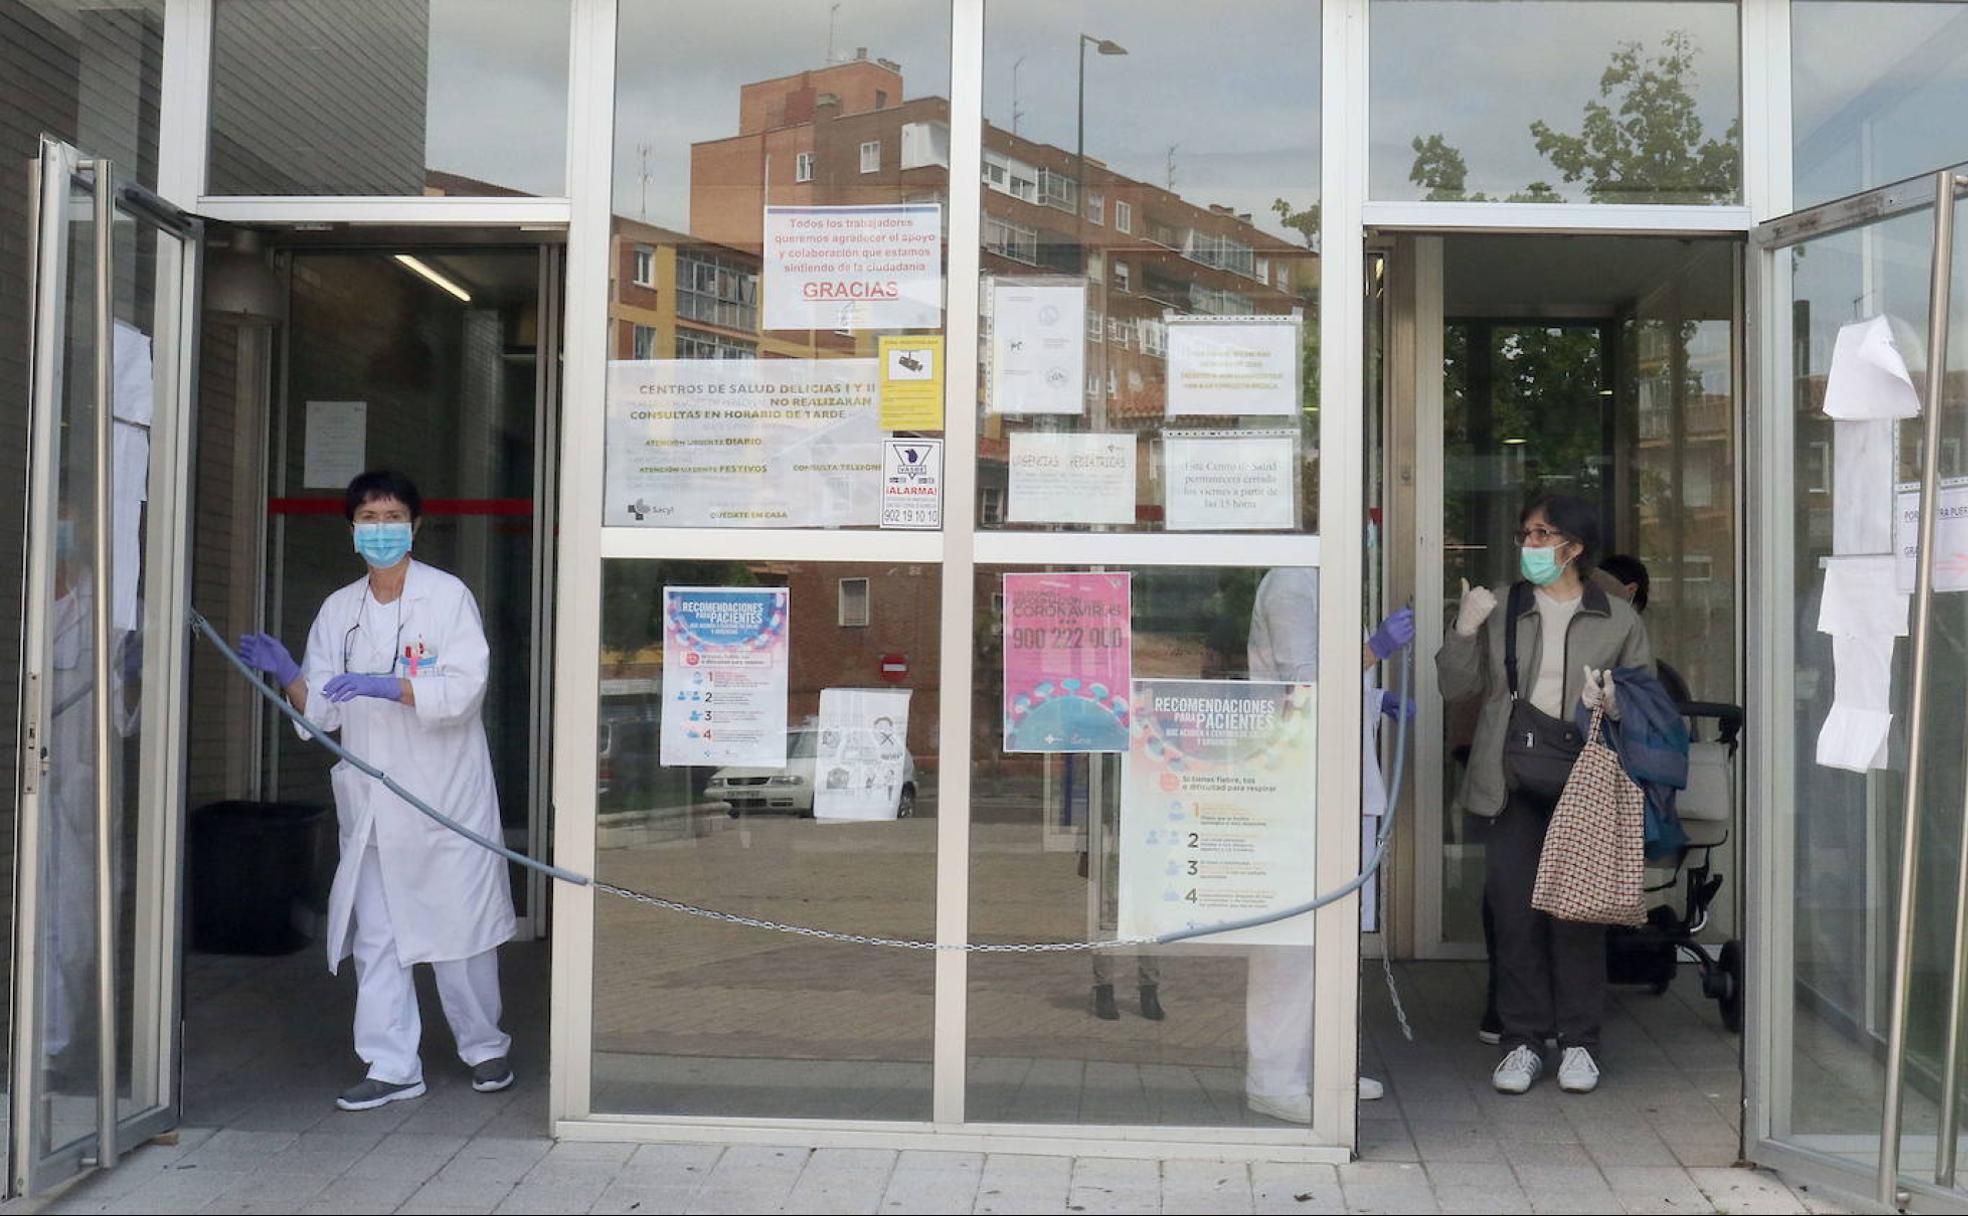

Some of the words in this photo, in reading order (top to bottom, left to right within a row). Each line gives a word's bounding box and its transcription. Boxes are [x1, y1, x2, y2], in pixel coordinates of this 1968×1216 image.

[790, 218, 823, 228] Todos
[826, 218, 843, 228] los
[846, 217, 914, 229] trabajadores
[774, 235, 829, 245] queremos
[889, 234, 899, 243] el
[902, 234, 935, 245] apoyo
[779, 251, 785, 260] y
[862, 250, 882, 260] que
[884, 249, 931, 258] estamos
[784, 263, 834, 273] sintiendo
[837, 263, 851, 272] de
[853, 263, 864, 272] la
[802, 281, 899, 299] GRACIAS
[639, 383, 704, 394] CENTROS
[708, 384, 726, 394] DE
[729, 383, 775, 394] SALUD
[780, 383, 841, 394] DELICIAS
[853, 383, 862, 393] Y
[769, 398, 789, 407] NO
[630, 410, 701, 420] CONSULTAS
[704, 410, 721, 419] EN
[724, 410, 783, 419] HORARIO
[786, 410, 802, 419] DE
[805, 409, 846, 419] TARDE
[725, 437, 762, 447] DIARIO
[719, 464, 769, 474] FESTIVOS
[792, 463, 837, 472] CONSULTA
[1206, 462, 1236, 472] Centro
[1250, 462, 1278, 472] Salud
[1233, 499, 1257, 509] horas
[884, 509, 900, 523] 902
[902, 510, 914, 522] 19
[915, 510, 926, 523] 10
[928, 510, 939, 522] 10
[682, 601, 764, 613] RECOMENDACIONES
[1012, 603, 1122, 618] CORONAVIRUS
[711, 612, 763, 624] PACIENTES
[1012, 627, 1046, 649] 900
[1050, 627, 1084, 648] 222
[708, 671, 713, 682] 1
[704, 691, 713, 703] 2
[1154, 697, 1275, 713] RECOMENDACIONES
[704, 710, 712, 721] 3
[1173, 713, 1196, 722] PARA
[1196, 714, 1275, 730] PACIENTES
[703, 729, 711, 740] 4
[1246, 785, 1277, 793] respirar
[1193, 803, 1200, 817] 1
[1187, 832, 1199, 849] 2
[1187, 860, 1198, 876] 3
[1184, 888, 1198, 904] 4
